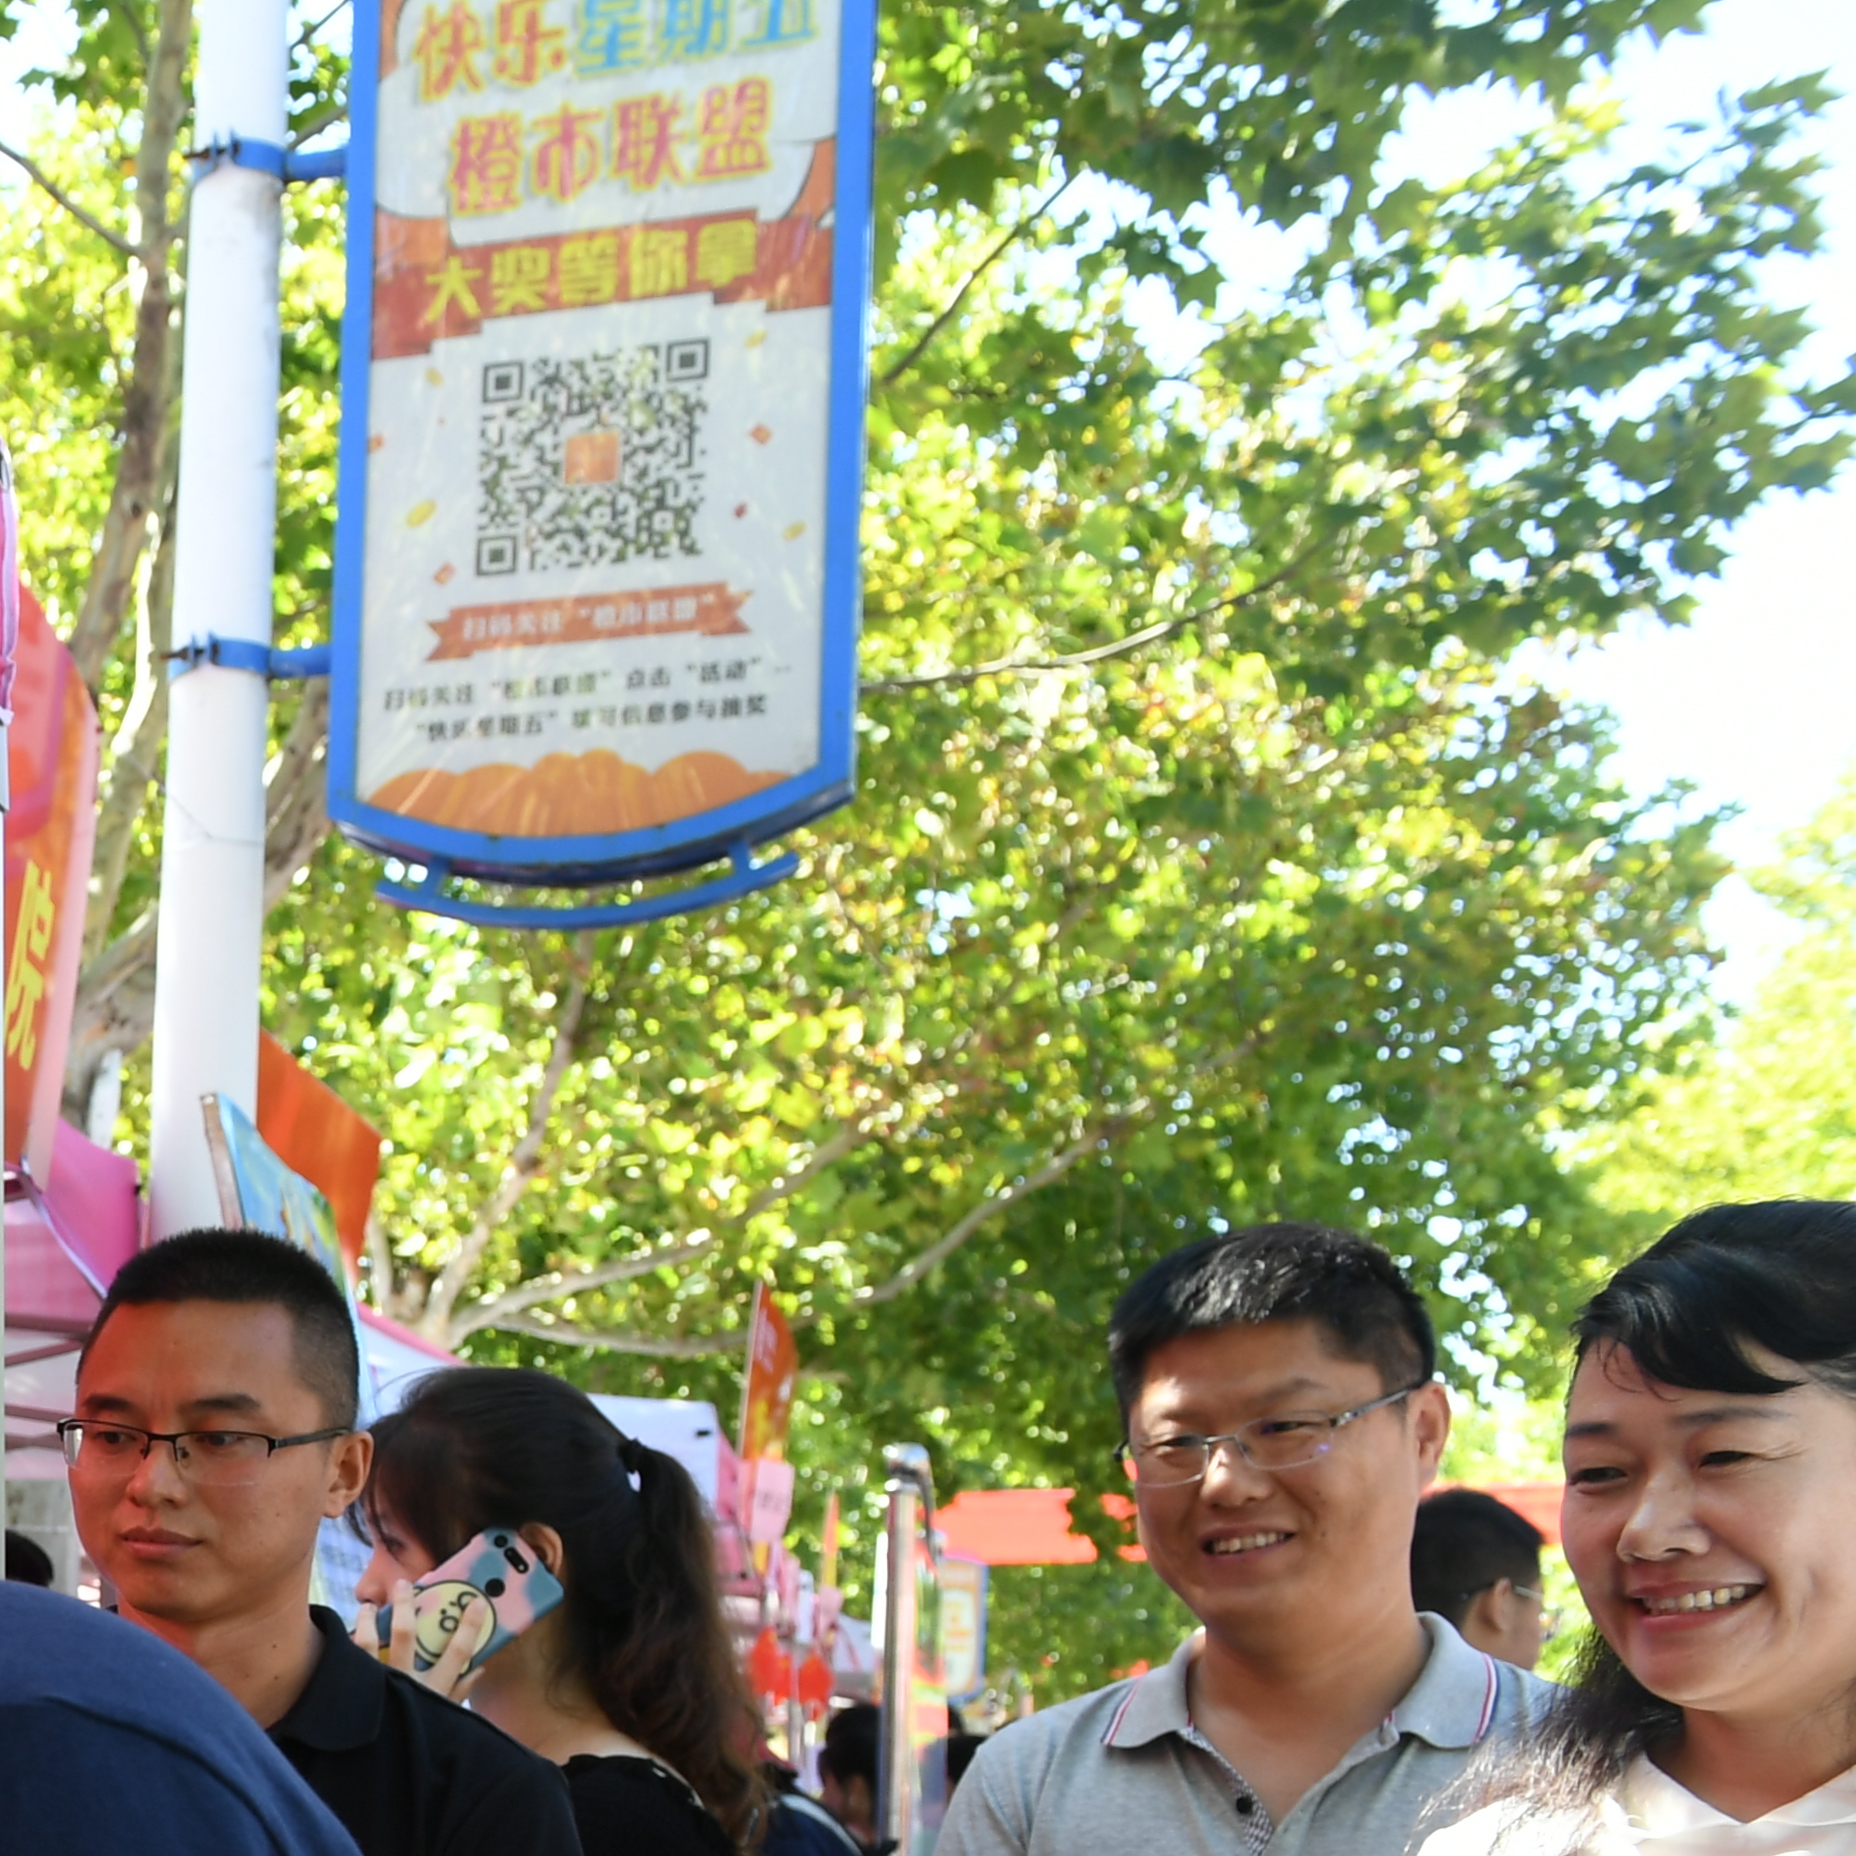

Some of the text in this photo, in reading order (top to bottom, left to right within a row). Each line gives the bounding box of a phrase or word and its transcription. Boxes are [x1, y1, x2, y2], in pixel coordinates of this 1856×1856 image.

[448, 77, 772, 217] 橙市联盟
[425, 217, 759, 322] 大奖等你拿
[3, 859, 55, 1071] 院
